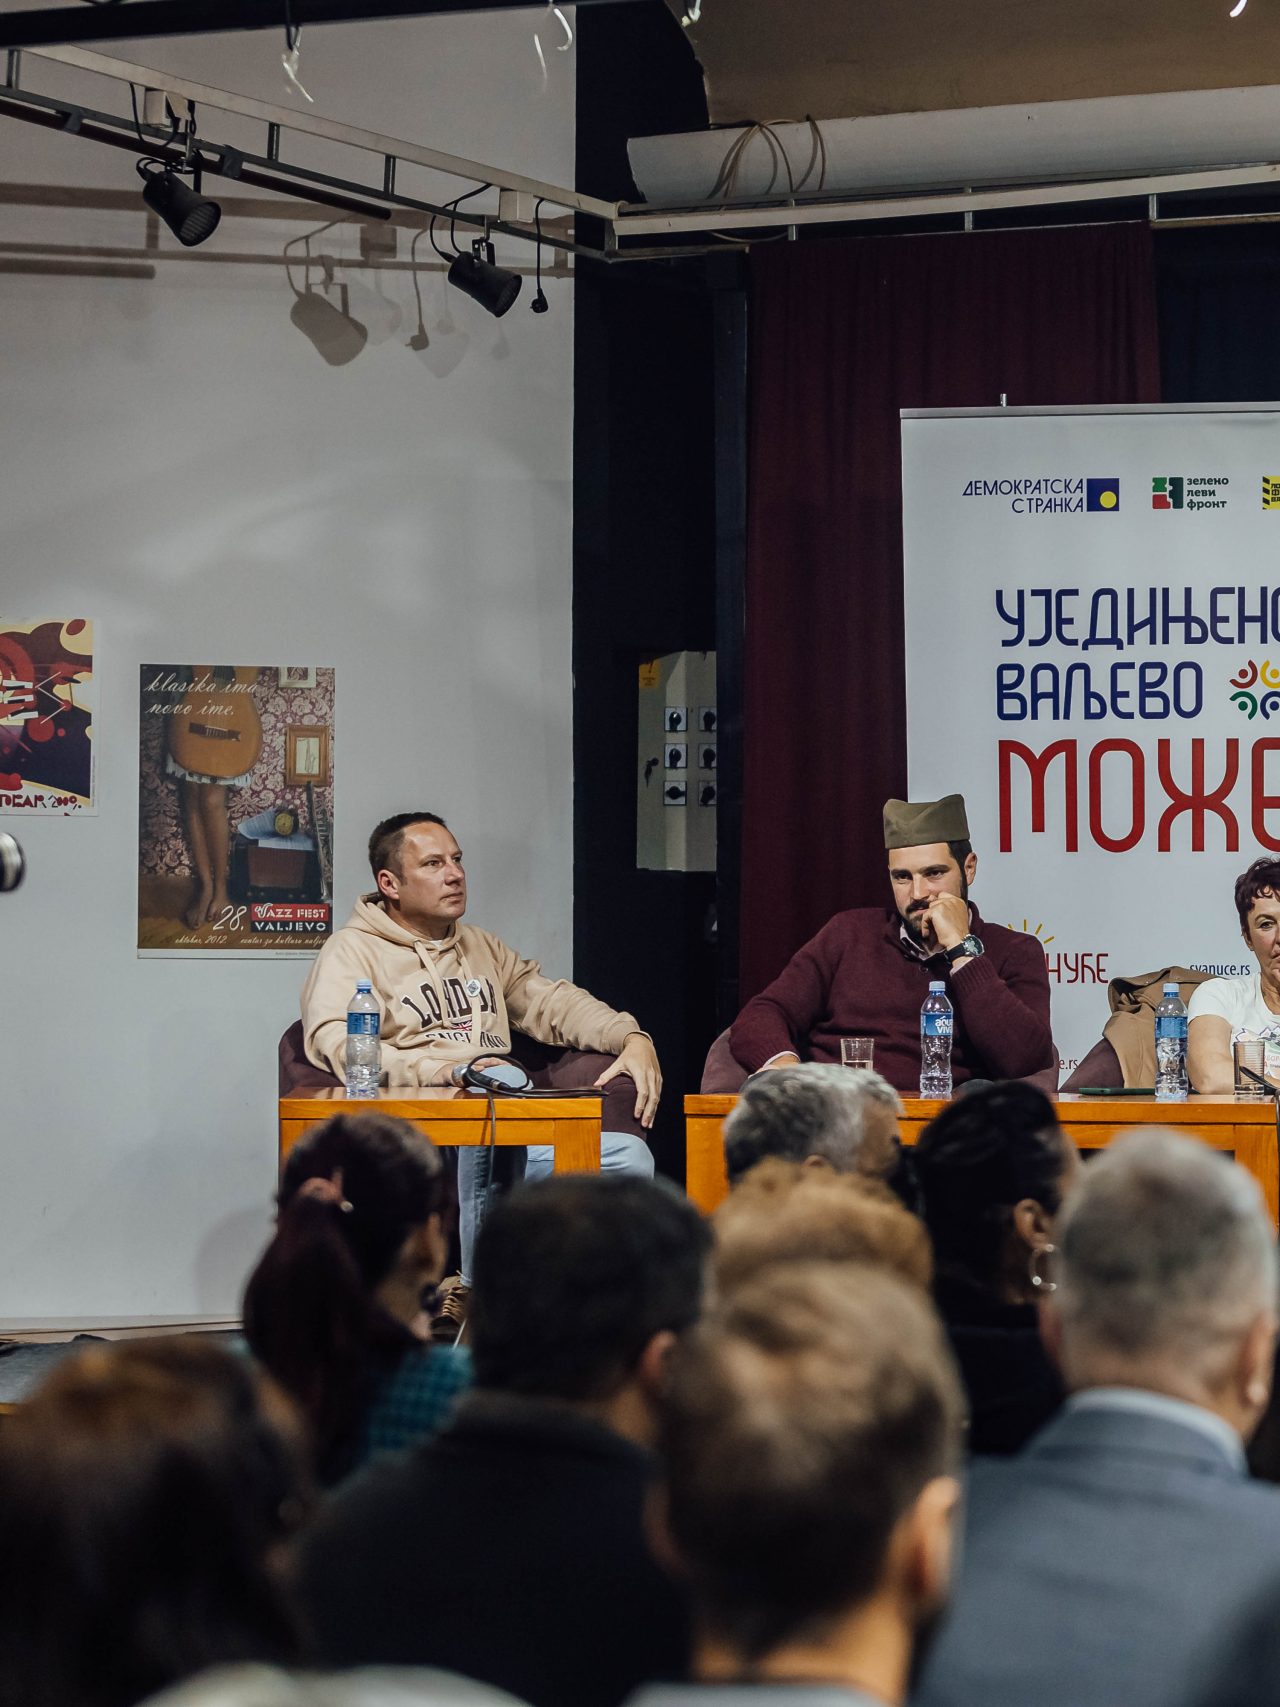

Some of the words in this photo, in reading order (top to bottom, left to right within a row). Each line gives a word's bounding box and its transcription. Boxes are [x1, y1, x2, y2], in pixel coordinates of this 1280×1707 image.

[962, 478, 1083, 496] ДЕМОКРАТСКА
[1187, 477, 1229, 486] зелено
[1187, 489, 1216, 497] леви
[1012, 497, 1083, 513] СТРАНКА
[1187, 499, 1227, 511] фронт
[144, 671, 216, 693] klasika
[219, 678, 258, 694] ima
[996, 660, 1203, 720] ВАЉЕВО
[145, 703, 192, 715] novo
[198, 699, 234, 715] ime.
[212, 905, 247, 931] 28.
[255, 902, 293, 918] JAZZ
[297, 909, 326, 918] FEST
[255, 922, 326, 931] VALJEVO
[1046, 953, 1109, 983] НУЋЕ
[935, 1015, 953, 1027] aqu
